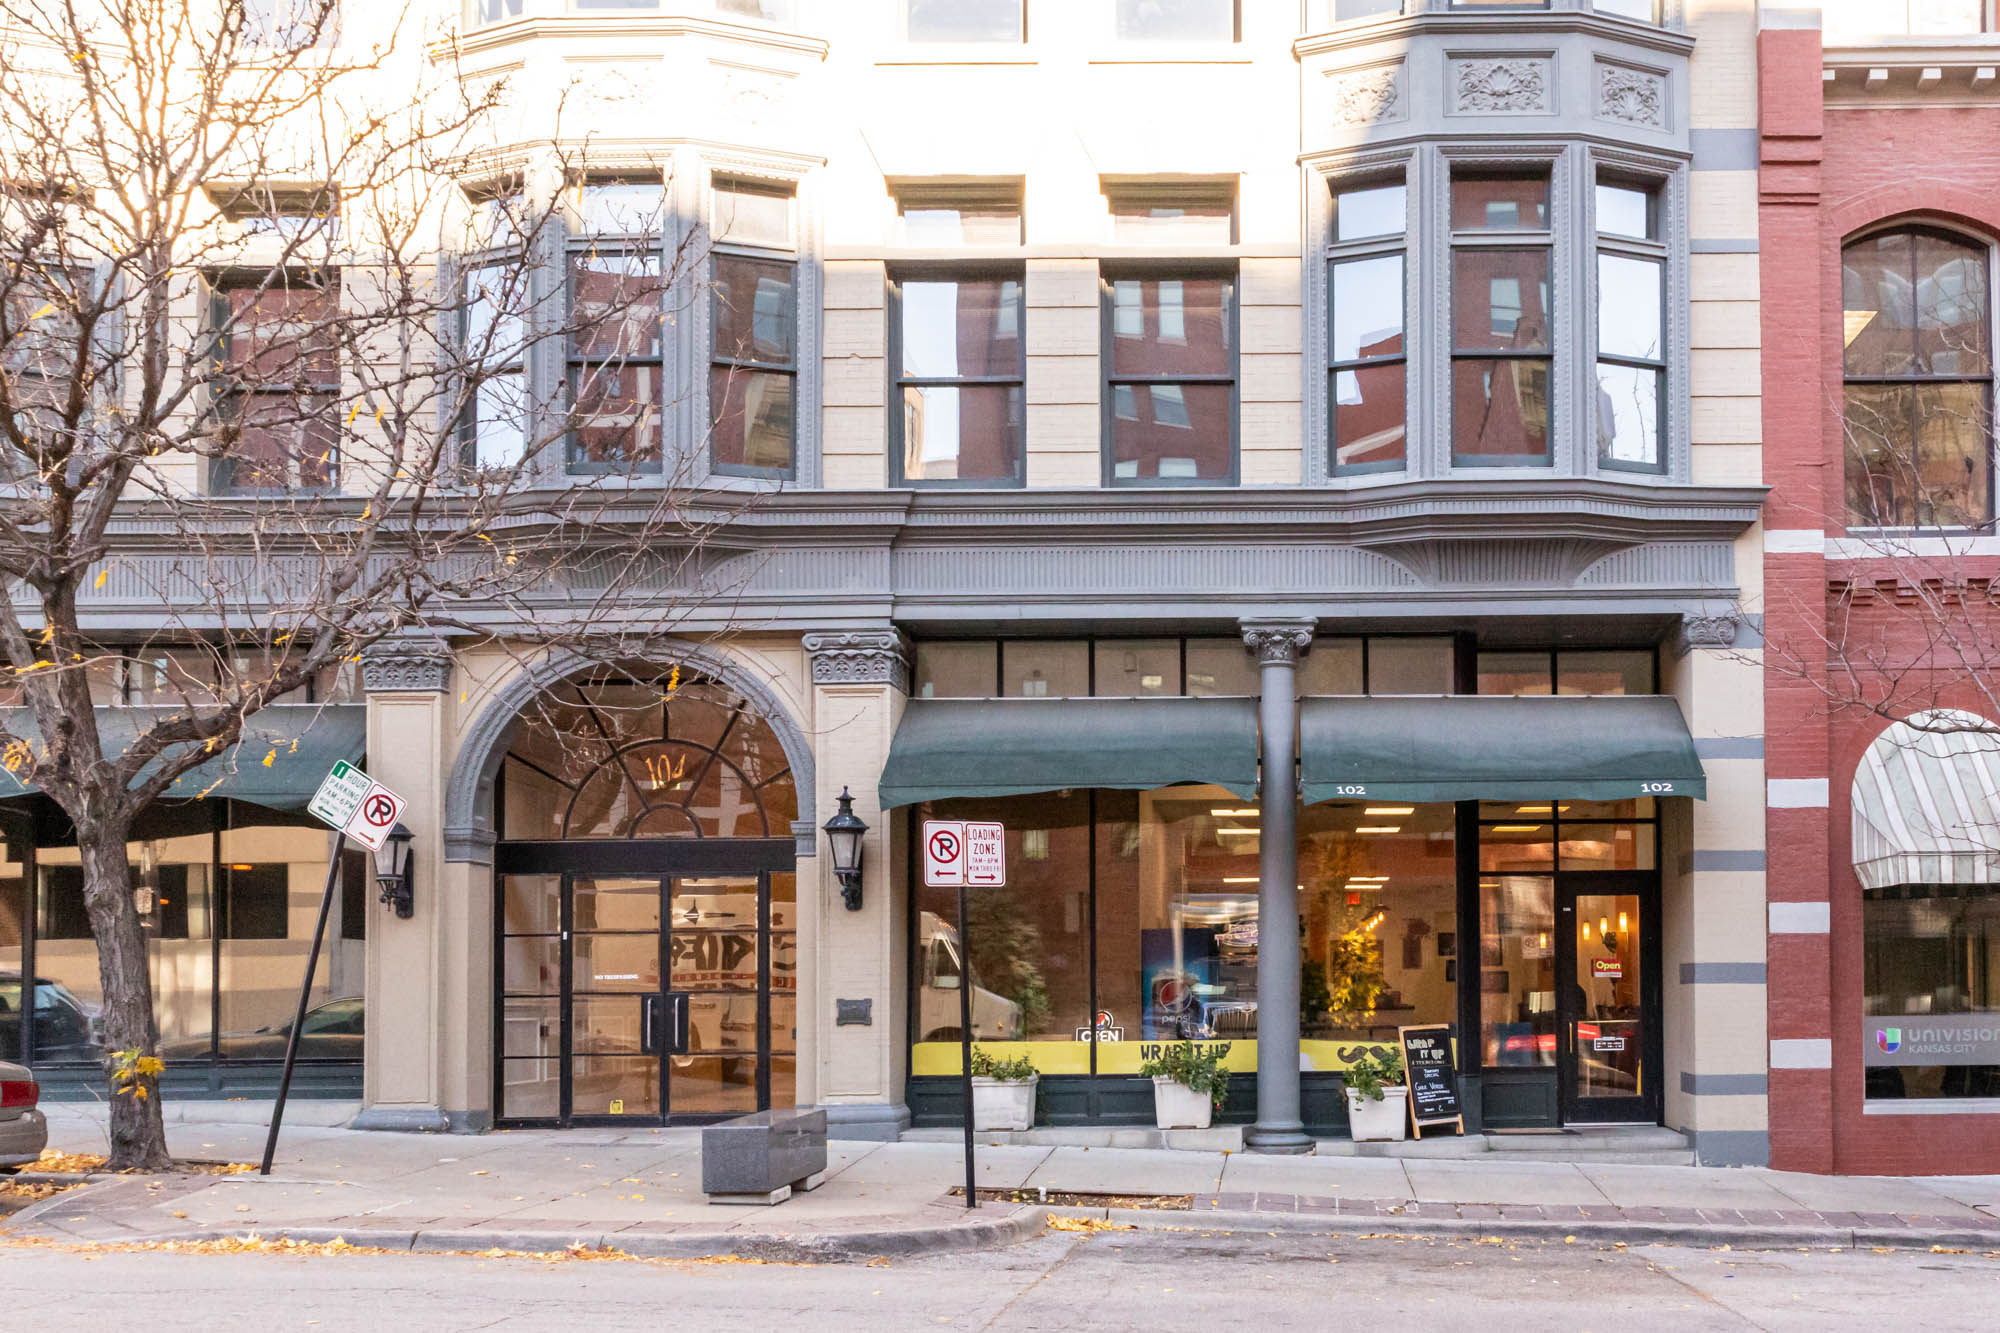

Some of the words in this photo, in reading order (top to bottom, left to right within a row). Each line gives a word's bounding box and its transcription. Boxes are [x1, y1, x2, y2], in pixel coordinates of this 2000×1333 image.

[347, 772, 367, 790] HOUR
[329, 778, 360, 801] PARKING
[1336, 785, 1366, 795] 102
[1641, 782, 1674, 793] 102
[968, 828, 1000, 841] LOADING
[973, 843, 996, 855] ZONE
[1595, 960, 1621, 971] Open
[1908, 1043, 1952, 1054] KANSAS
[1953, 1043, 1977, 1054] CITY
